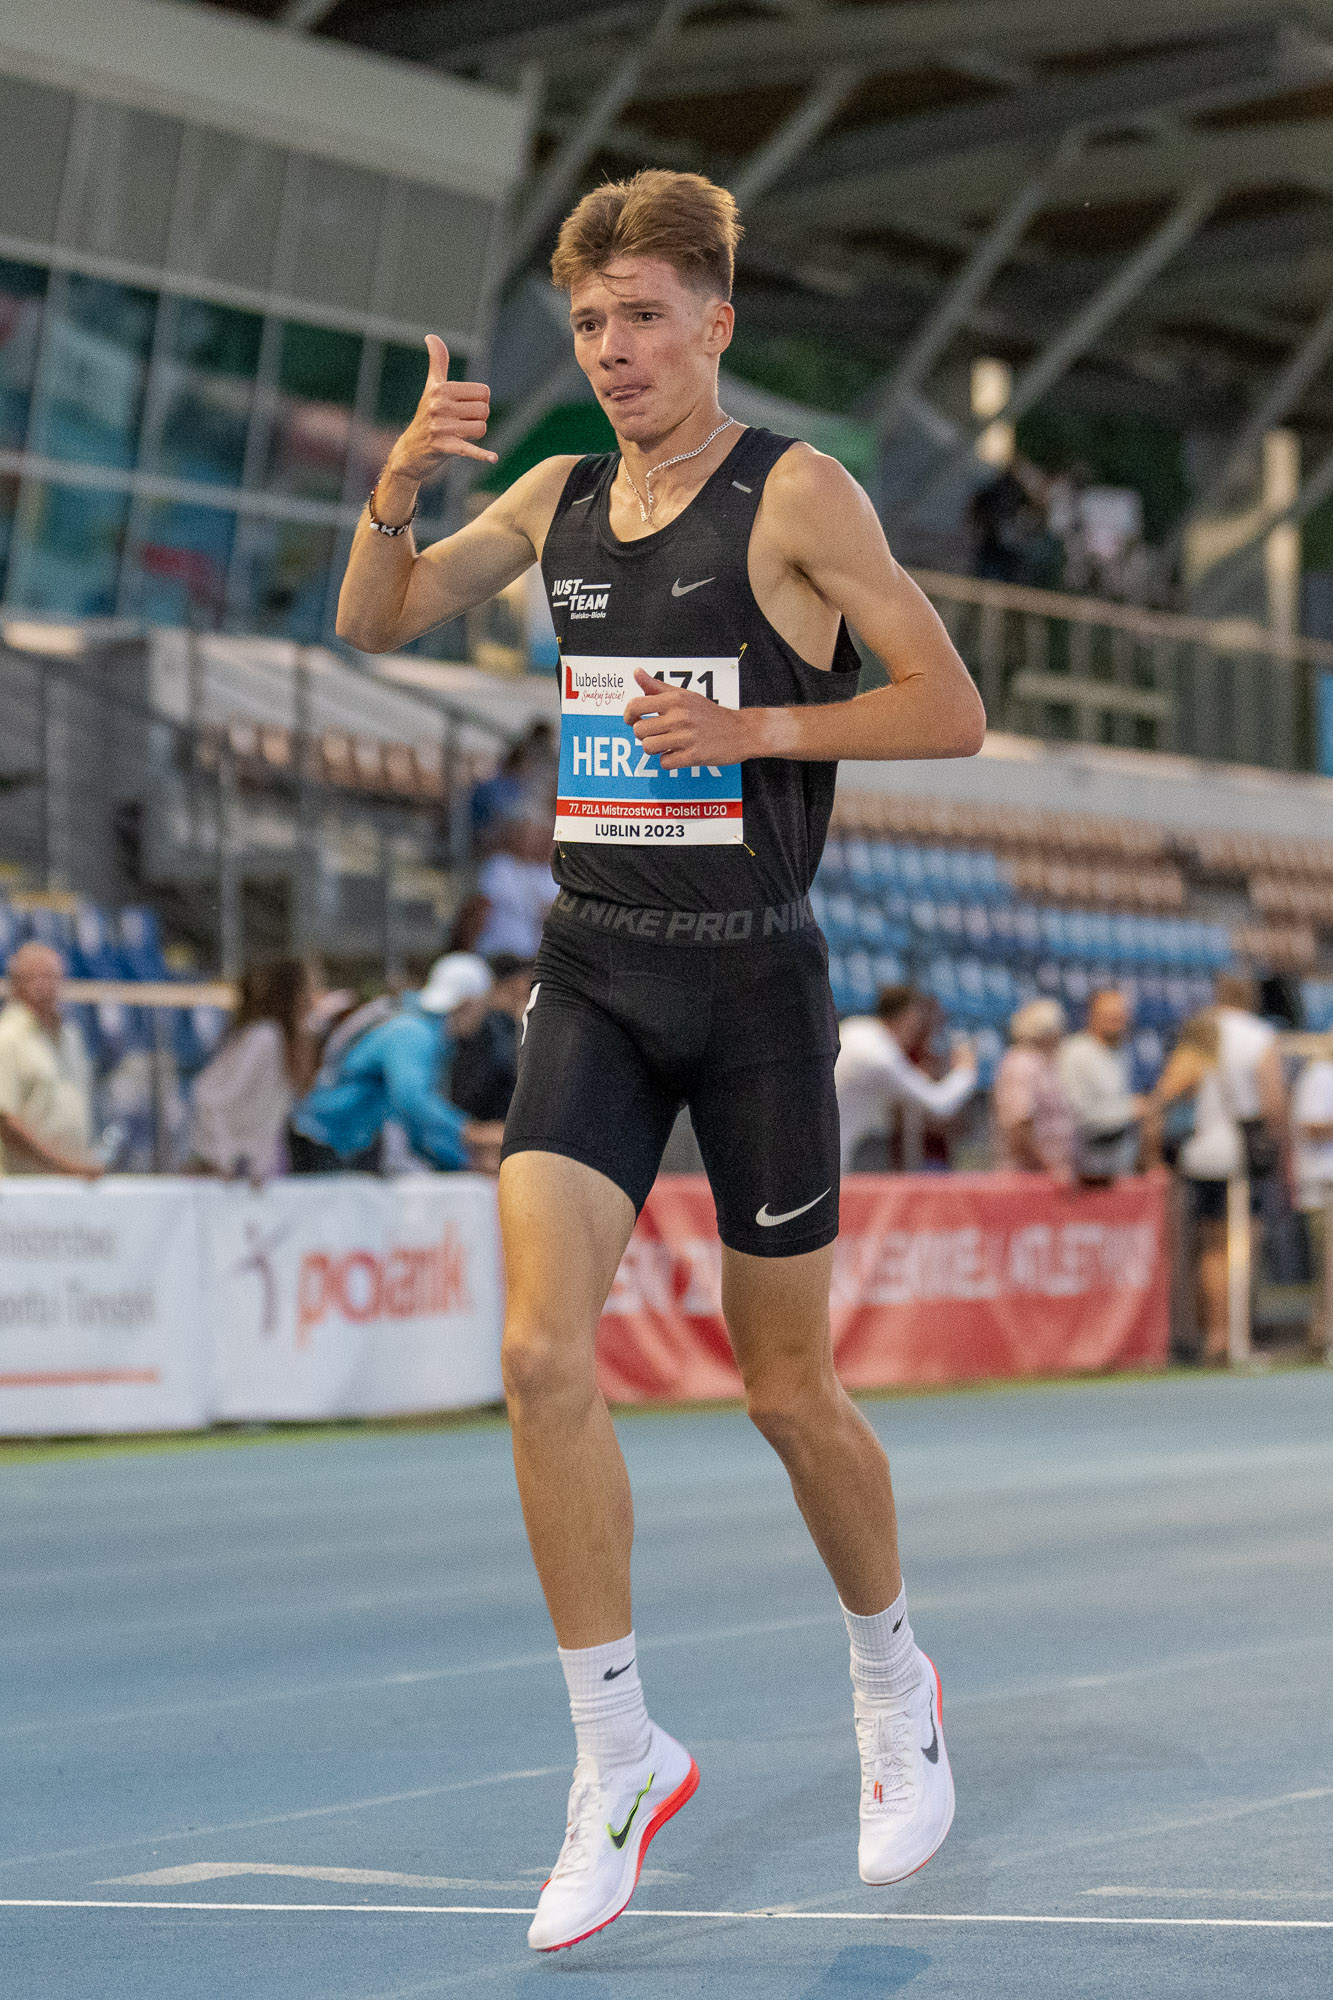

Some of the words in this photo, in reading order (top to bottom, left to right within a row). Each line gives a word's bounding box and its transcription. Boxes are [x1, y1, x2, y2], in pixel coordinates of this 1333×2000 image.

[551, 578, 584, 596] JUST
[568, 593, 609, 611] TEAM
[575, 672, 624, 688] lubelskie
[573, 735, 722, 778] HERZ
[568, 803, 581, 814] 77.
[581, 804, 600, 815] PZLA
[601, 806, 663, 817] Mistrzostwa
[665, 805, 700, 817] Polski
[703, 805, 728, 816] U20
[595, 823, 640, 838] LUBLIN
[644, 825, 685, 838] 2023
[578, 900, 664, 937] NIKE
[665, 909, 752, 941] PRO
[762, 893, 814, 936] NIK
